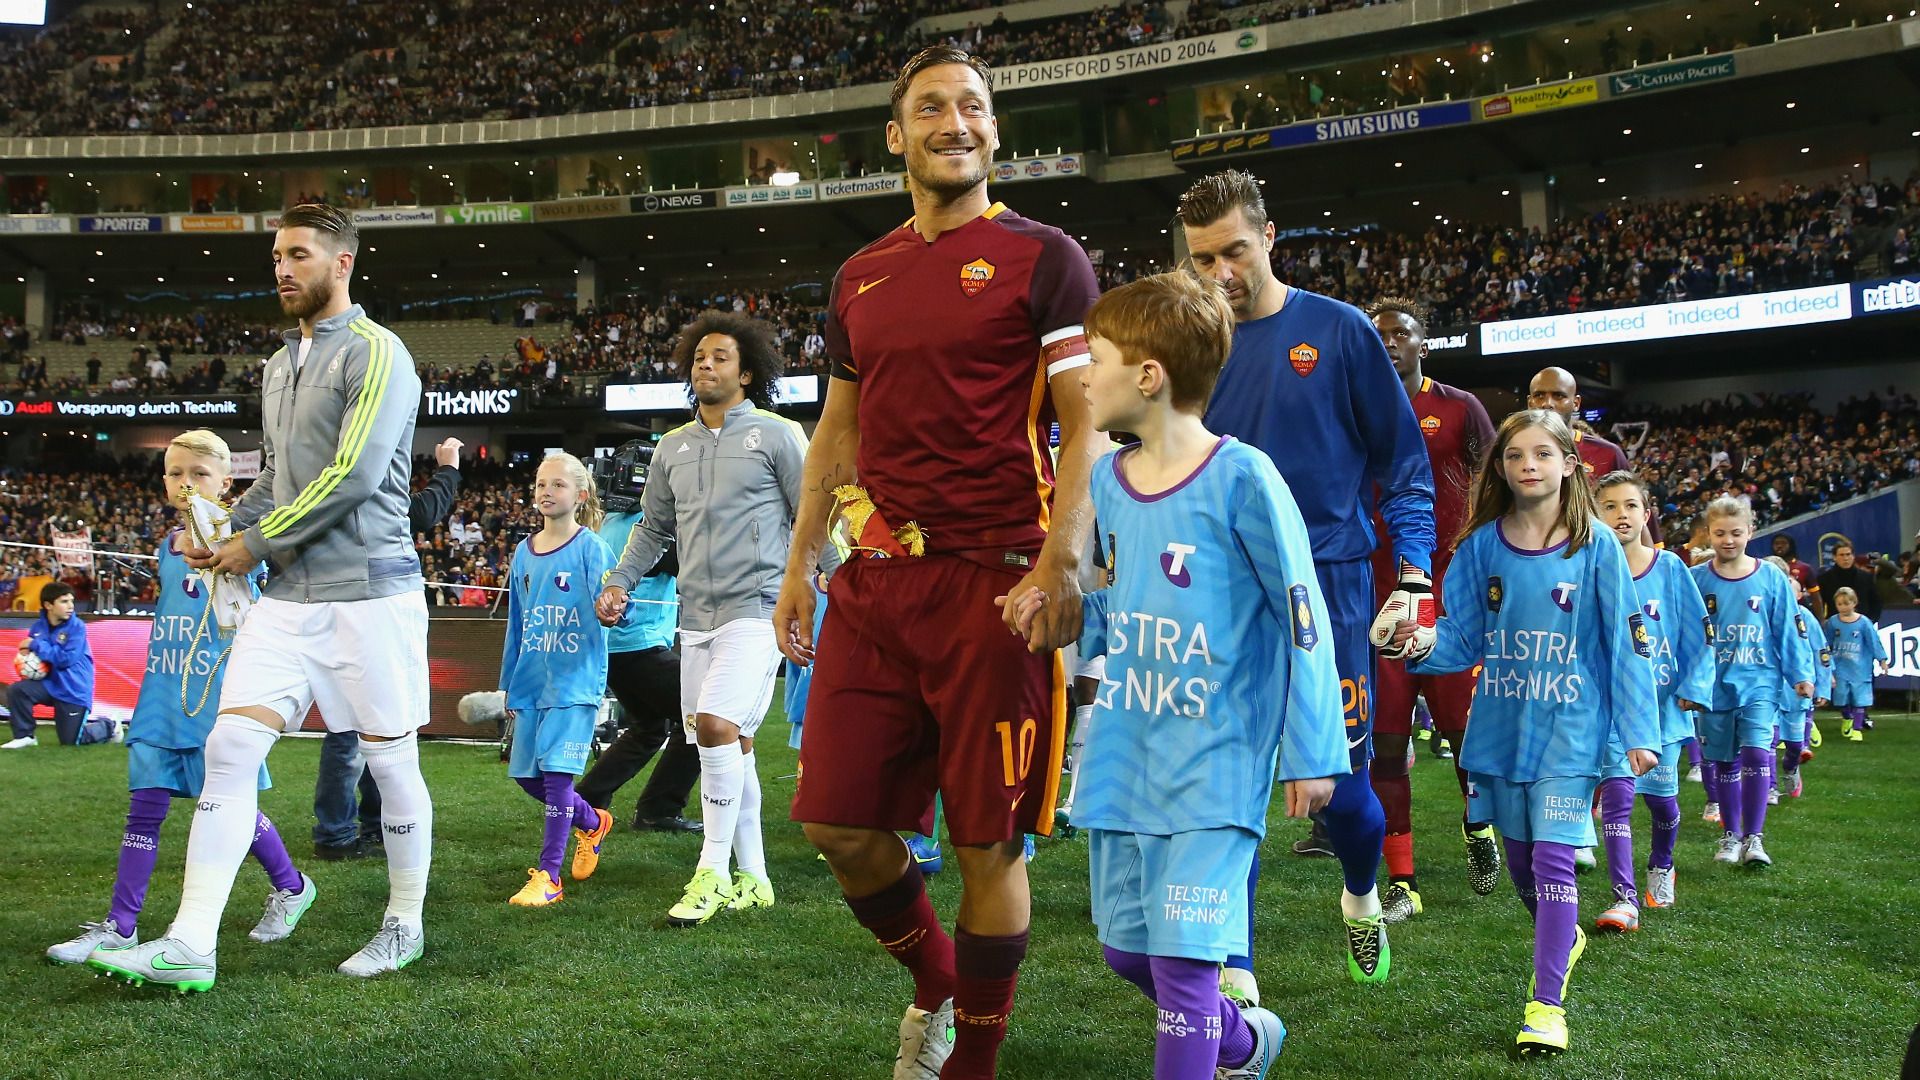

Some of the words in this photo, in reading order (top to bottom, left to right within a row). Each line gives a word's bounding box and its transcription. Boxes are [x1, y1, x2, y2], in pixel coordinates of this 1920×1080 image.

[1001, 71, 1012, 86] H
[1018, 58, 1110, 83] PONSFORD
[1116, 47, 1172, 70] STAND
[1177, 39, 1216, 60] 2004
[1514, 90, 1556, 104] Healthy
[1568, 84, 1594, 95] Care
[1316, 110, 1420, 141] SAMSUNG
[825, 178, 898, 196] ticketmaster
[540, 205, 572, 216] WOLF
[578, 202, 617, 214] BLASS
[661, 195, 702, 208] NEWS
[459, 205, 523, 224] 9mile
[104, 218, 150, 231] PORTER
[962, 280, 985, 288] ROMA
[1491, 321, 1556, 344] indeed
[1577, 312, 1646, 335] indeed
[1667, 301, 1740, 326] indeed
[1763, 290, 1839, 316] indeed
[15, 401, 53, 414] Audi
[57, 401, 136, 417] Vorsprung
[138, 401, 180, 415] durch
[182, 401, 237, 414] Technik
[995, 718, 1037, 787] 10
[1545, 795, 1586, 810] TELSTRA
[383, 821, 416, 835] RMCF
[124, 832, 153, 845] LSTRA
[1166, 884, 1228, 905] TELSTRA
[1543, 883, 1578, 897] TELSTR
